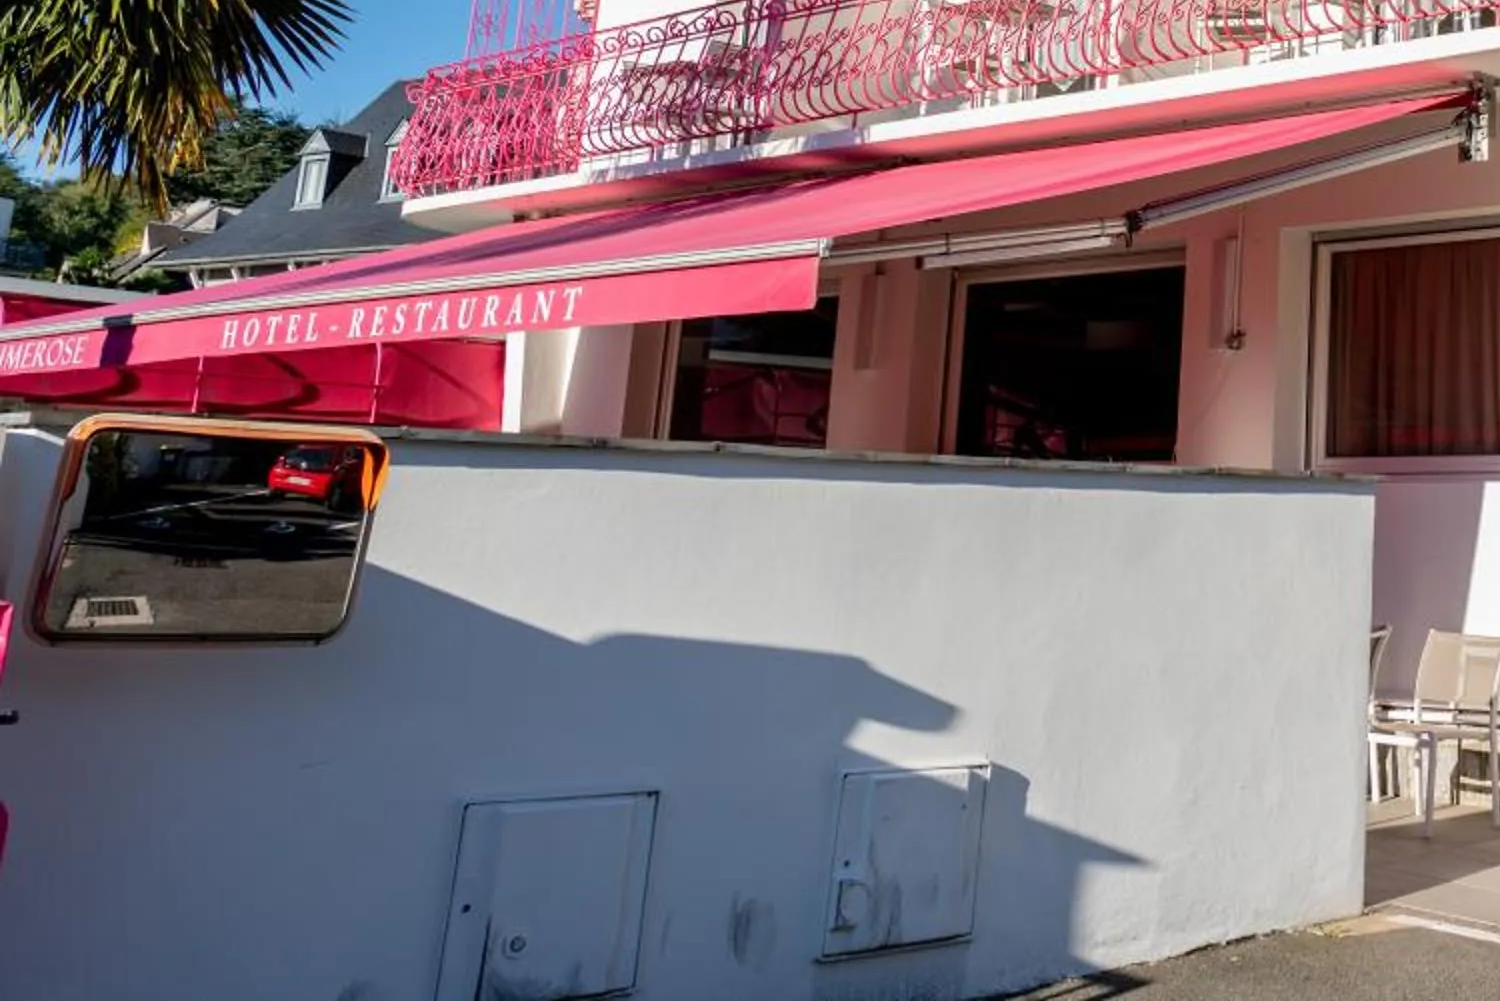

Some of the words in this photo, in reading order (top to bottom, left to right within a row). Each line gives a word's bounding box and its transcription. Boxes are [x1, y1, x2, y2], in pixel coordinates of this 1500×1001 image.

[221, 312, 318, 349] HOTEL
[348, 287, 584, 339] RESTAURANT
[0, 337, 88, 369] IMEROSE
